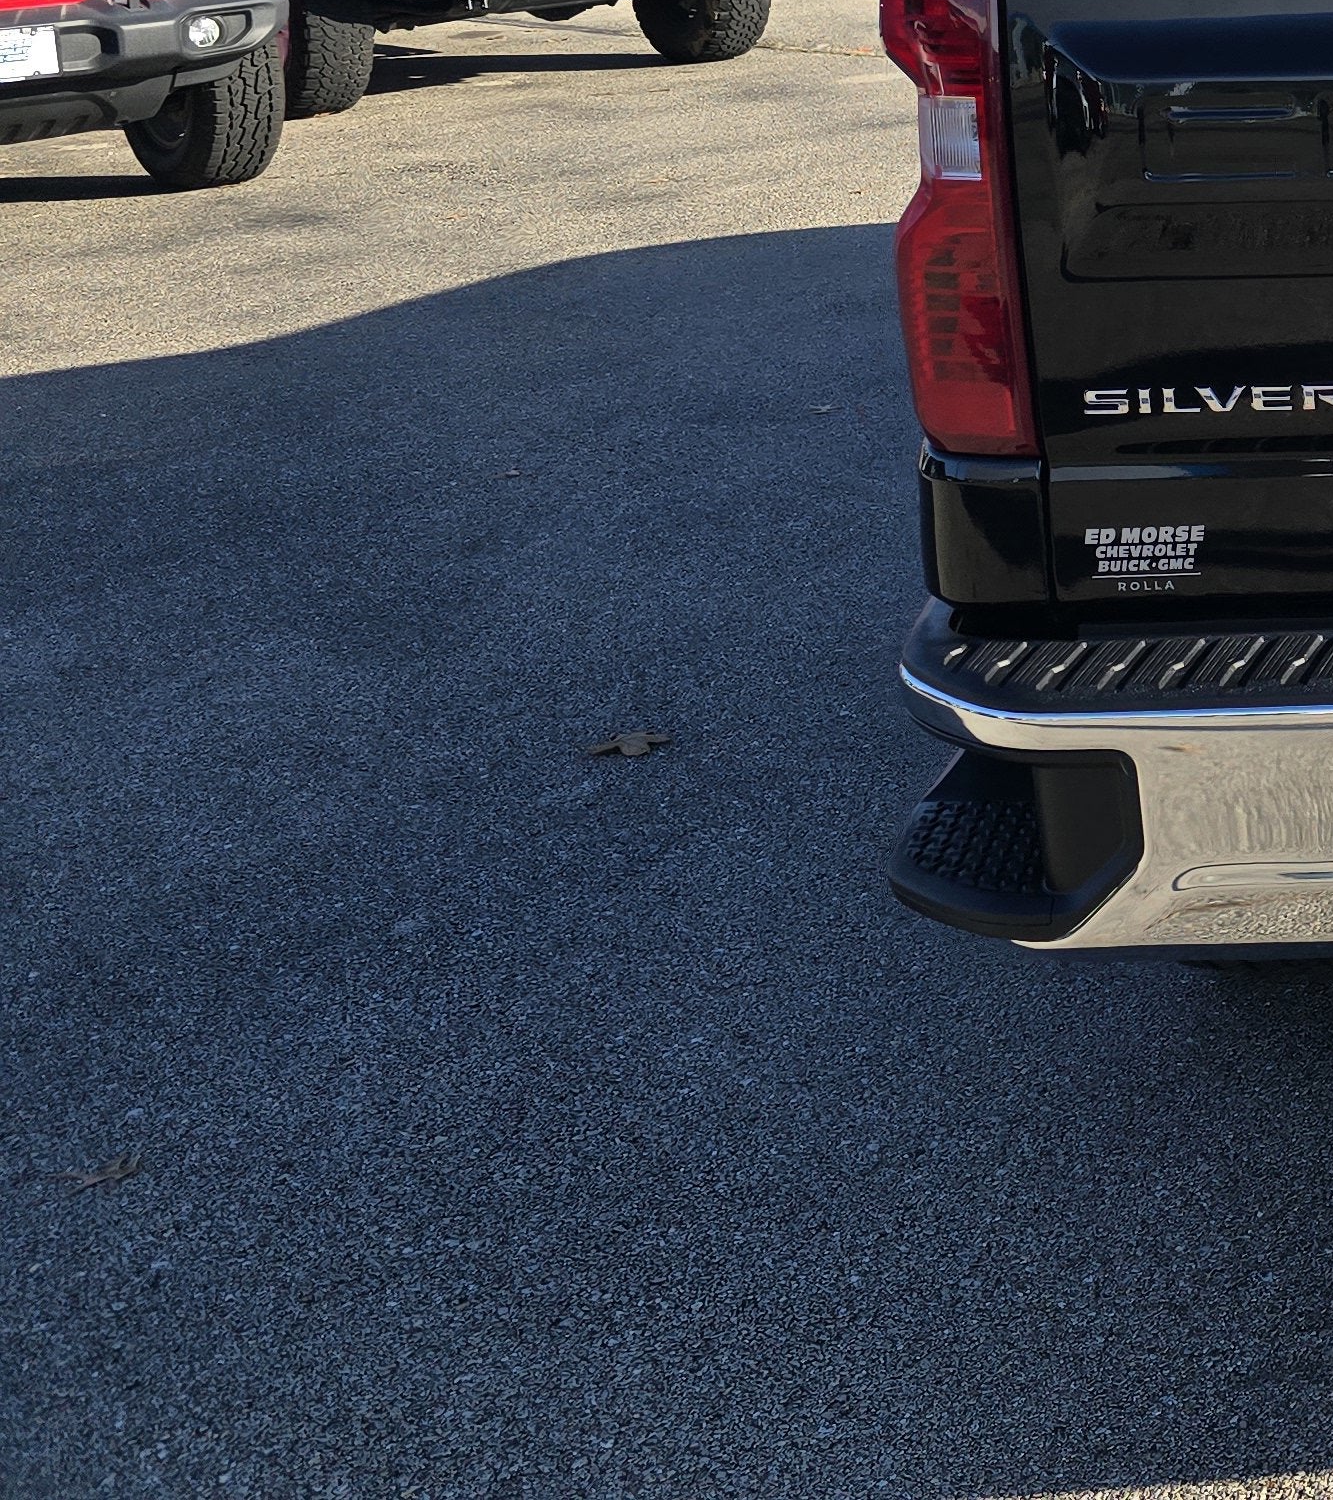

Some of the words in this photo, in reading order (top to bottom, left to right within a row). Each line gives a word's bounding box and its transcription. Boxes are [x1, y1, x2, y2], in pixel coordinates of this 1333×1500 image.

[1084, 527, 1116, 545] ED
[1120, 524, 1205, 544] MORSE
[1095, 542, 1198, 559] CHEVROLET
[1117, 580, 1175, 592] ROLLA
